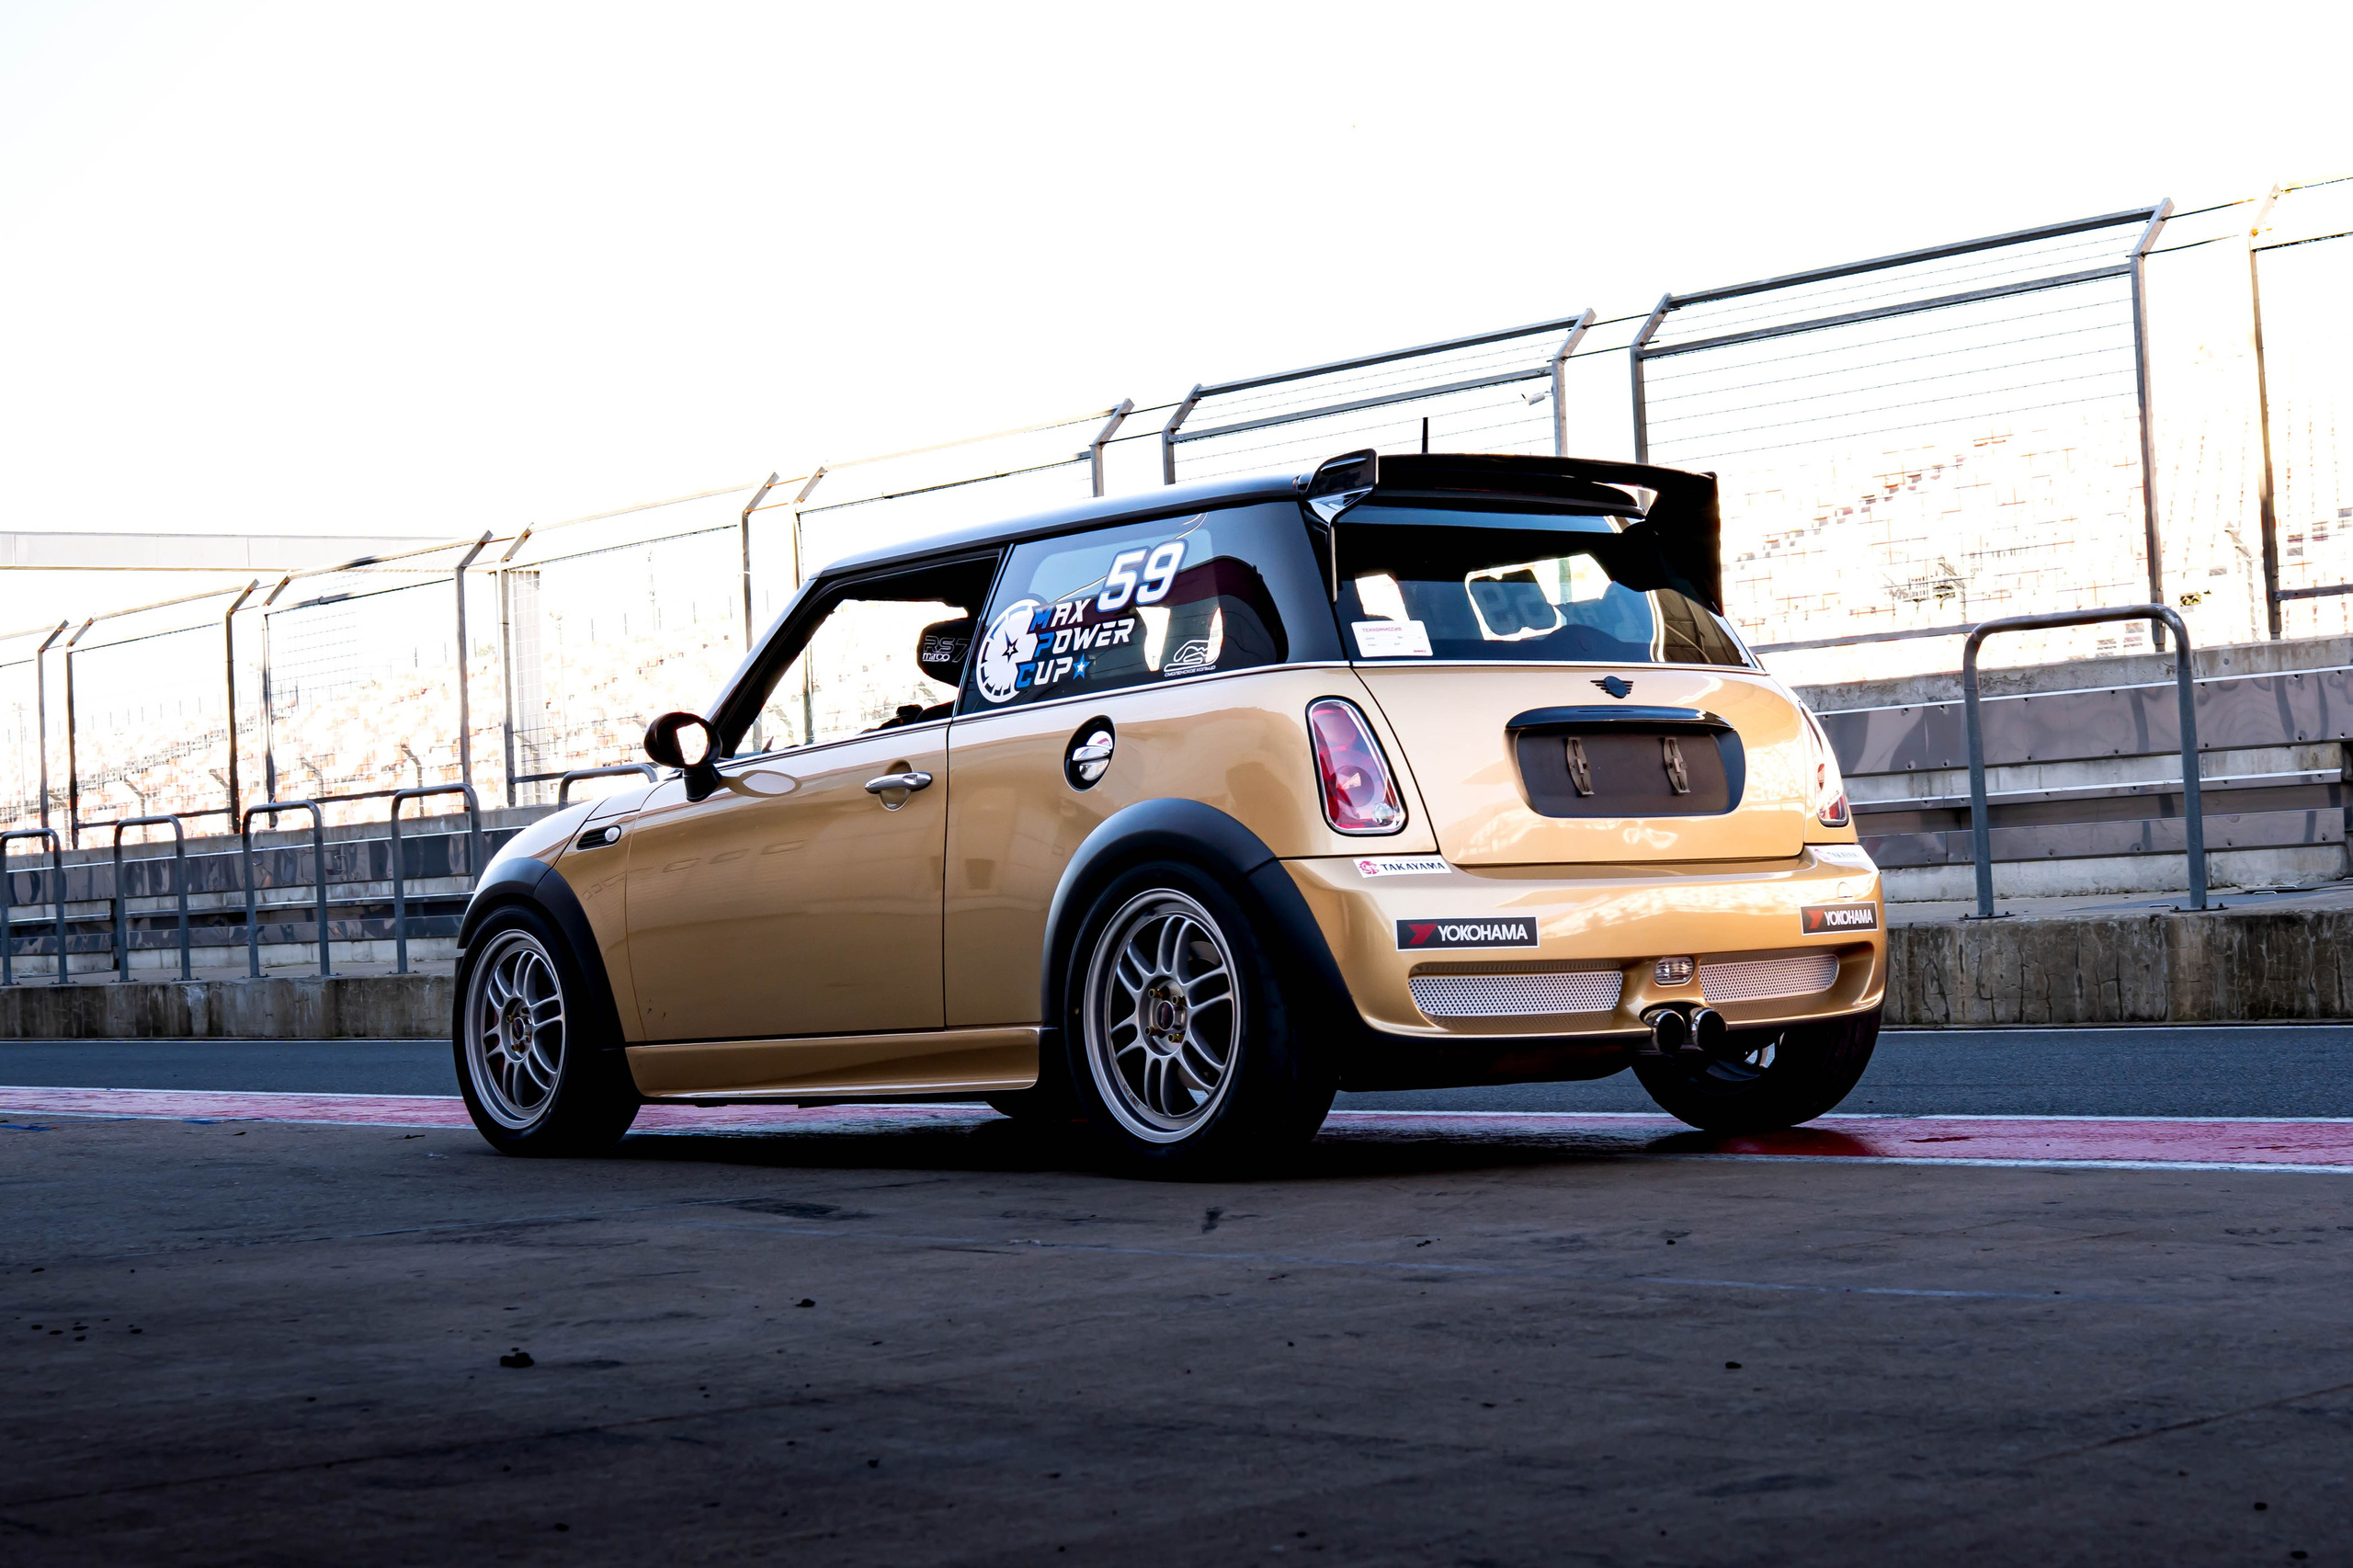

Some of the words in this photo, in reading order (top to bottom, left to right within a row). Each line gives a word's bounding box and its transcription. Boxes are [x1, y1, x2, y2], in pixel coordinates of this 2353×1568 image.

[1097, 540, 1186, 612] 59
[1029, 598, 1091, 631] MAX
[1034, 618, 1135, 657] POWER
[1015, 656, 1074, 688] CUP
[1380, 862, 1446, 870] TAKAYAMA
[1437, 923, 1528, 942] YOKOHAMA
[1824, 908, 1873, 926] YOKOHAMA
